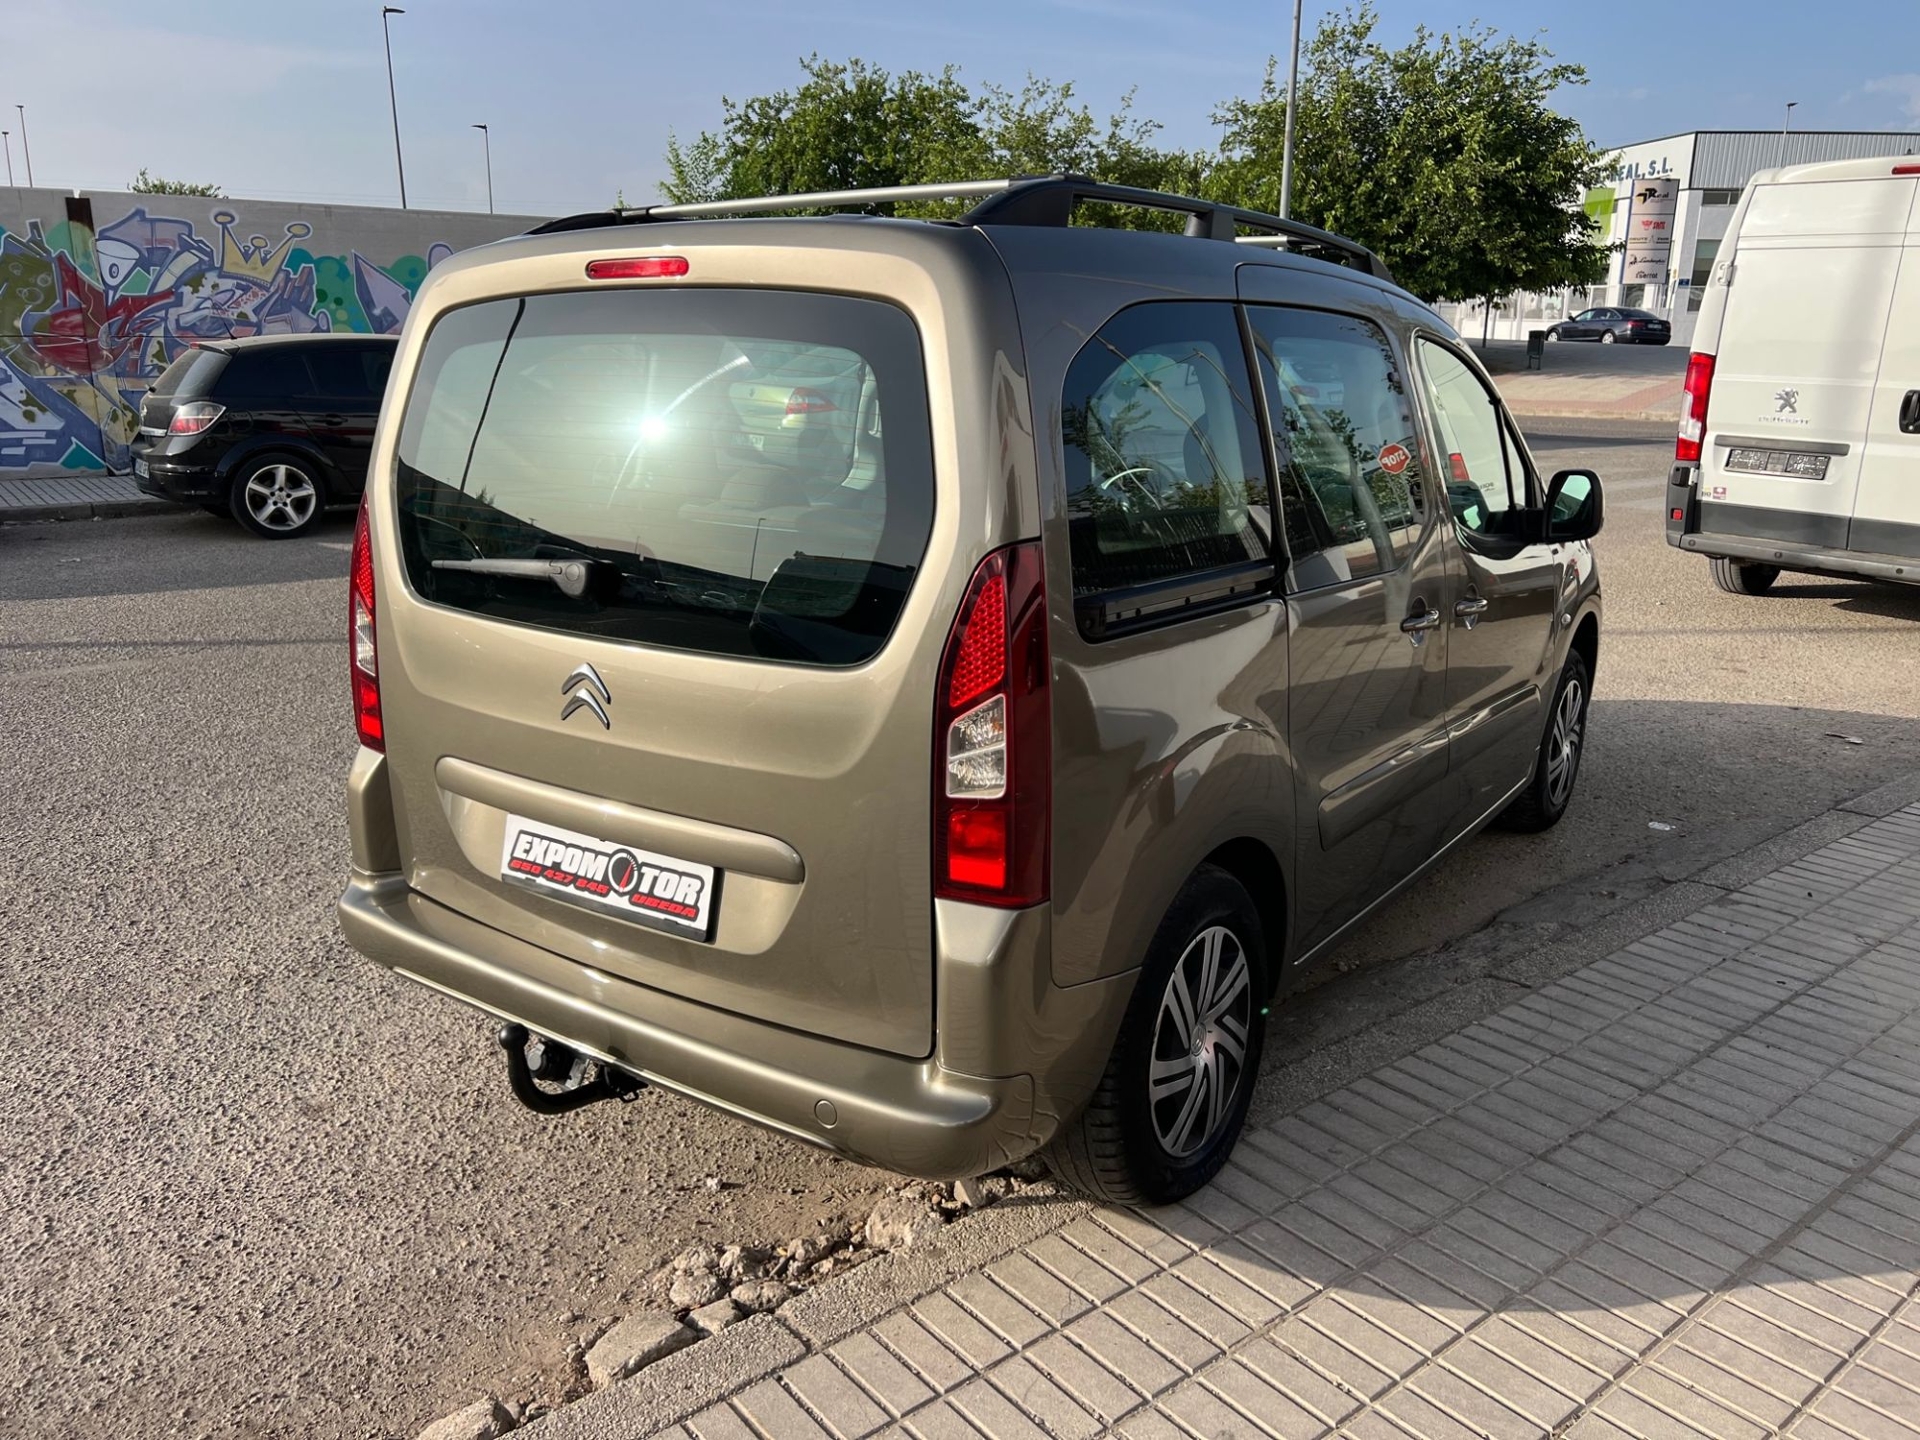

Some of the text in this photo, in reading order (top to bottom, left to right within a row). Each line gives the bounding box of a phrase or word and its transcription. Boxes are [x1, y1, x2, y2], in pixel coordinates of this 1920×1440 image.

[1648, 157, 1674, 176] S.L.
[510, 859, 543, 874] 650
[543, 869, 574, 884] 427
